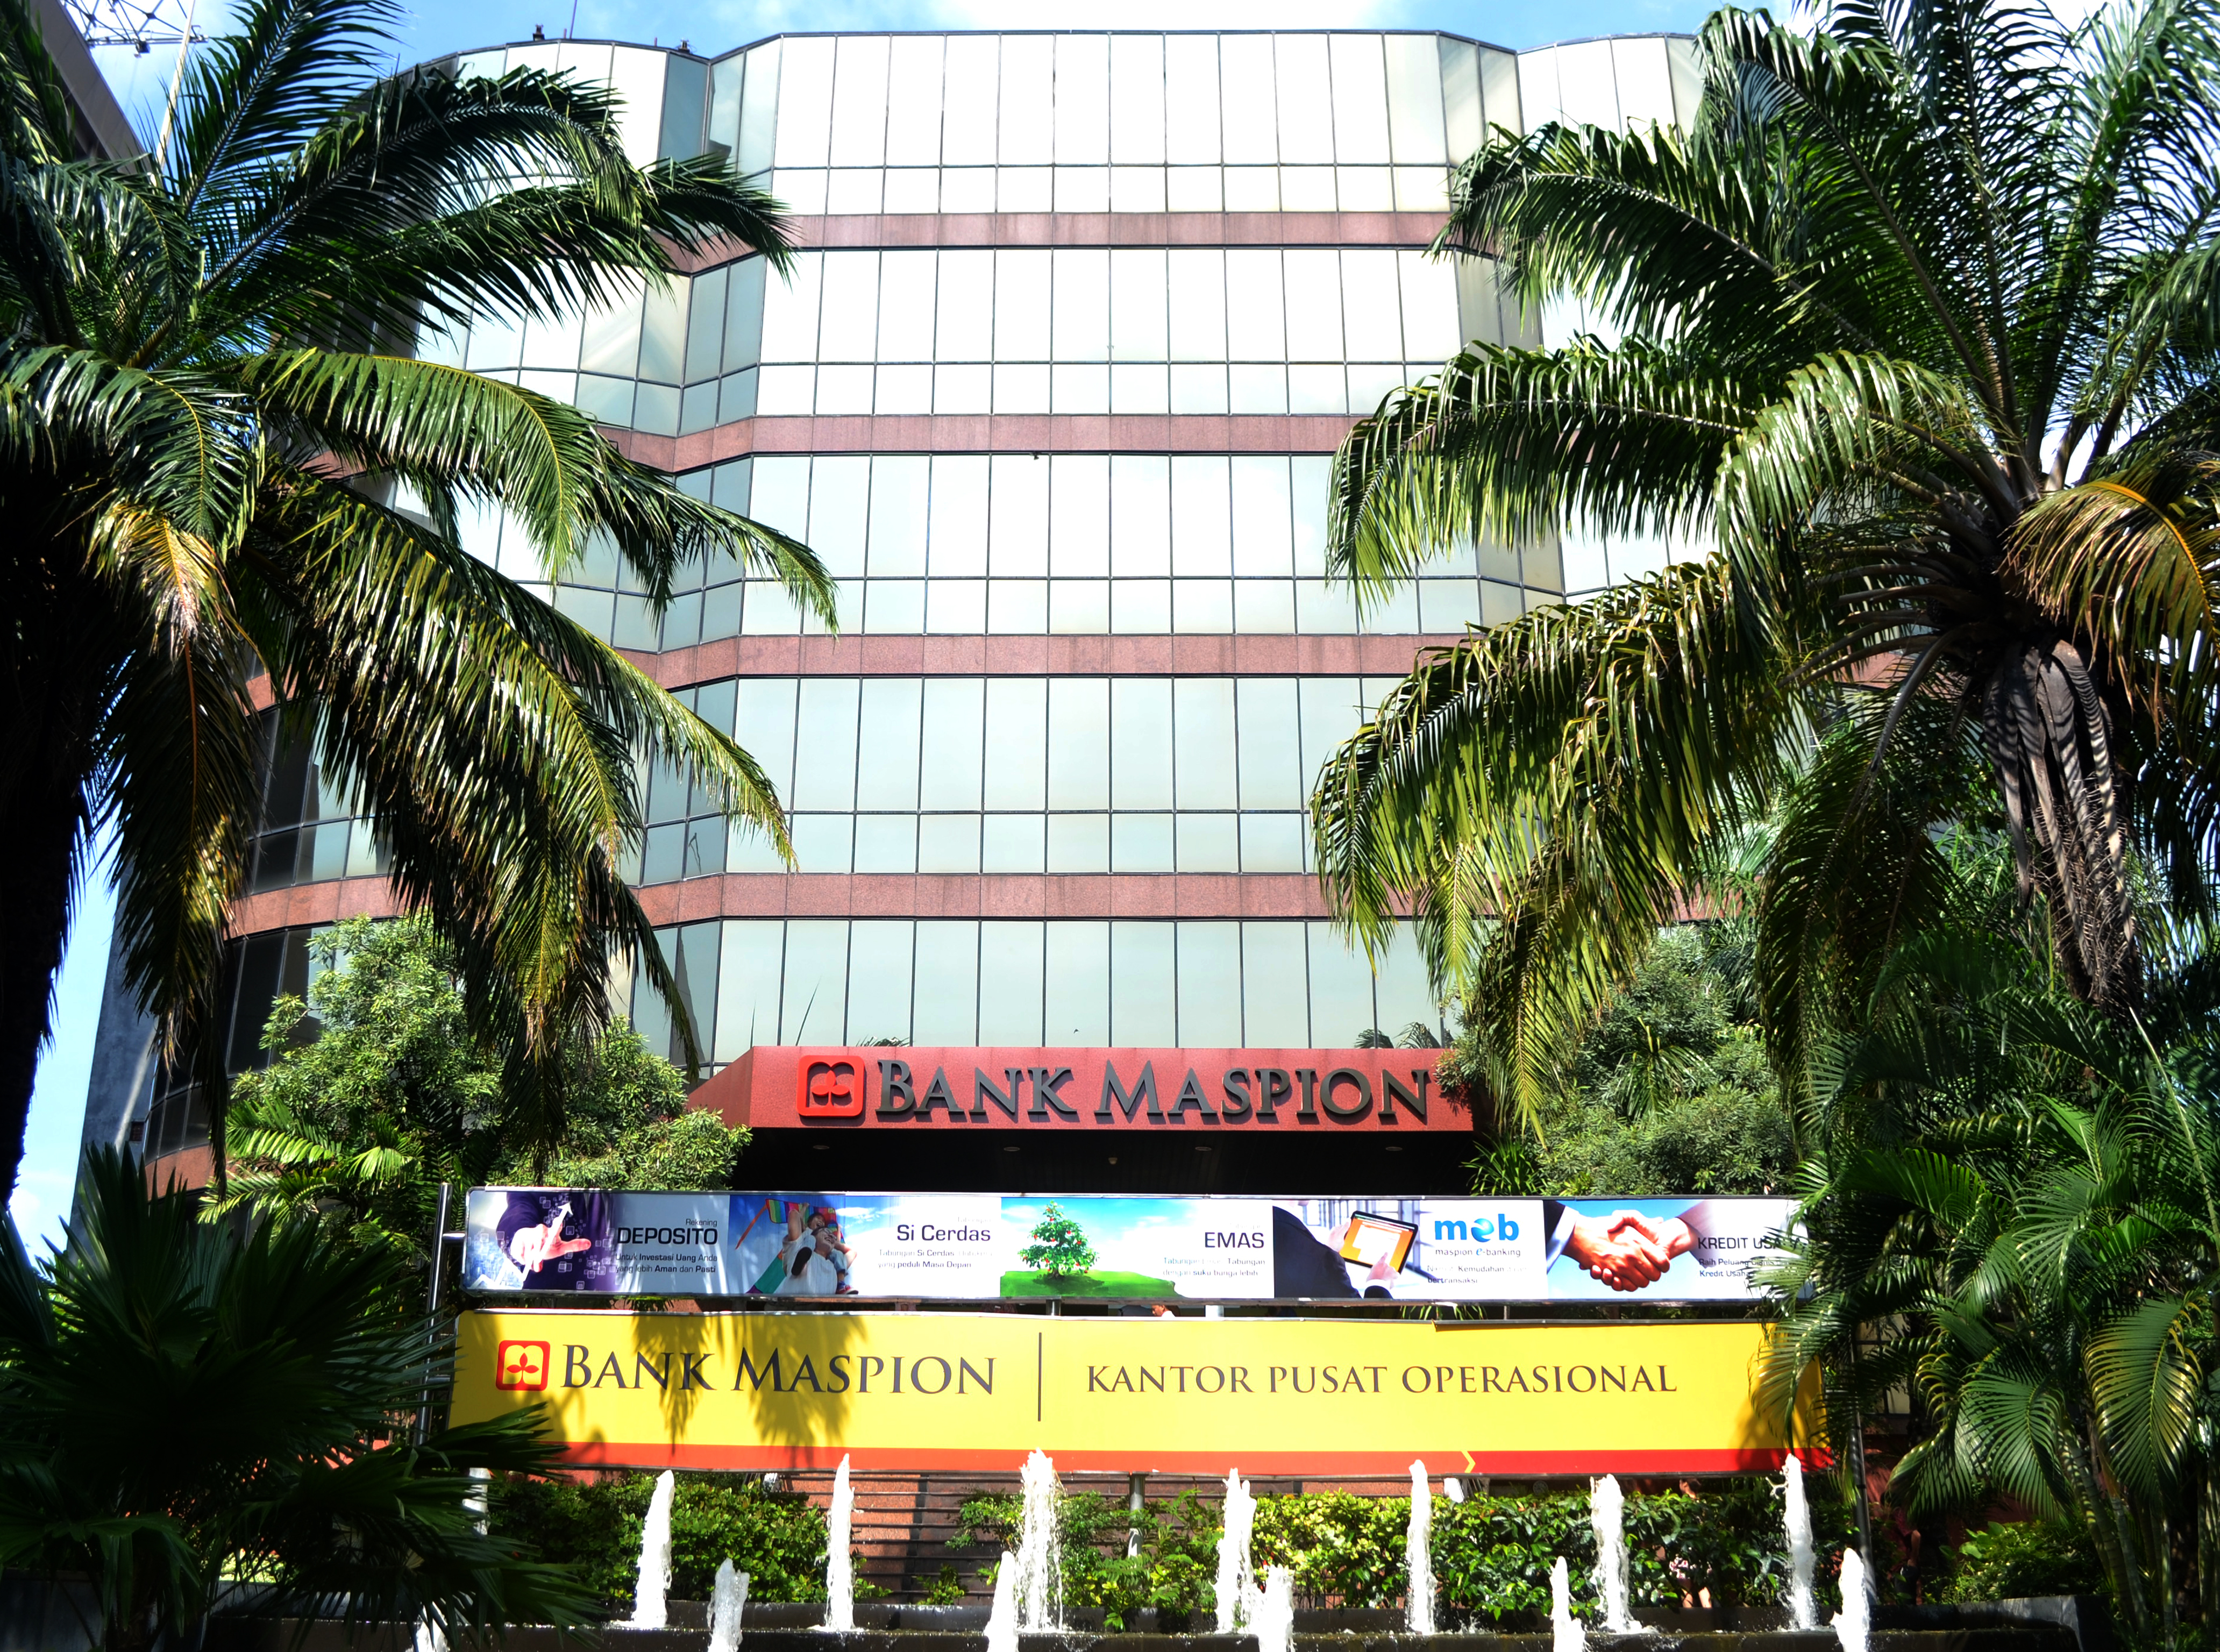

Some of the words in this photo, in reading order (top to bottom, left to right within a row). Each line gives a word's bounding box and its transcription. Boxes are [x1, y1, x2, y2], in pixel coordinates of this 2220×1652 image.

[875, 1059, 1077, 1115] BANK
[1094, 1059, 1429, 1116] MASPION
[686, 1219, 717, 1227] Rekening
[617, 1228, 718, 1245] DEPOSITO
[897, 1224, 914, 1241] Si
[921, 1224, 991, 1241] Cerdas
[1205, 1232, 1264, 1248] EMAS
[1698, 1237, 1748, 1249] KREDIT
[677, 1254, 696, 1263] Uang
[1435, 1249, 1472, 1257] maspion
[1476, 1248, 1521, 1257] e-banking
[561, 1344, 717, 1390] BANK
[731, 1347, 997, 1395] MASPION
[1087, 1366, 1255, 1393] KANTOR
[1269, 1366, 1388, 1393] PUSAT
[1402, 1365, 1677, 1393] OPERASIONAL
